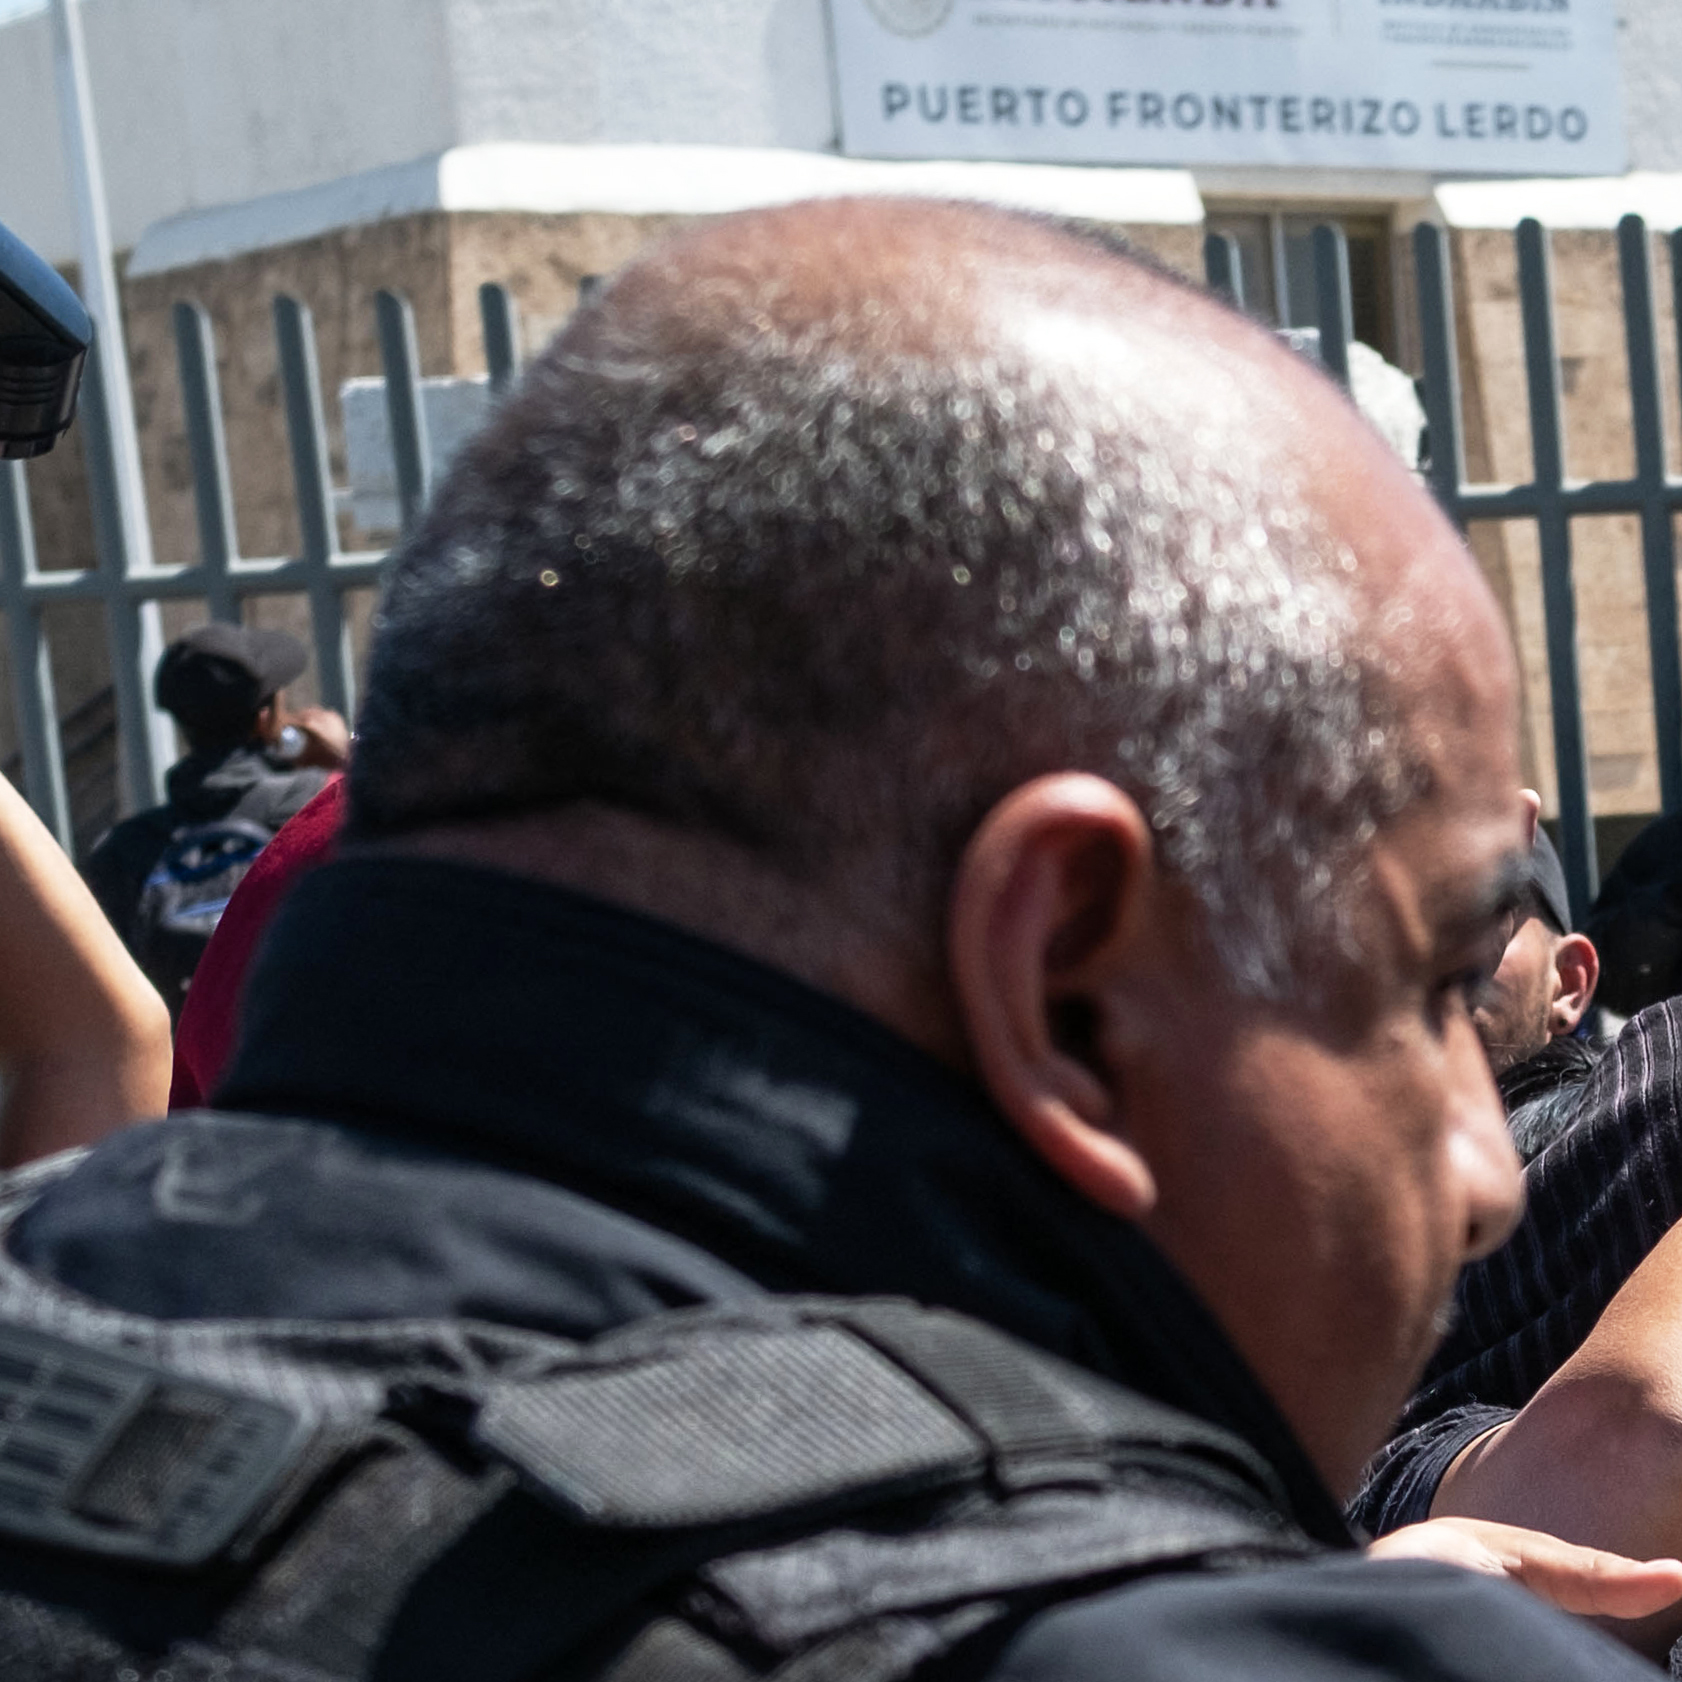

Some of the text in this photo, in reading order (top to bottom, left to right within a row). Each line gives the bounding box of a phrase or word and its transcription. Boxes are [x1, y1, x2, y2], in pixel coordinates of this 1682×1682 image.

[881, 82, 1590, 143] PUERTO FRONTERIZO LERDO
